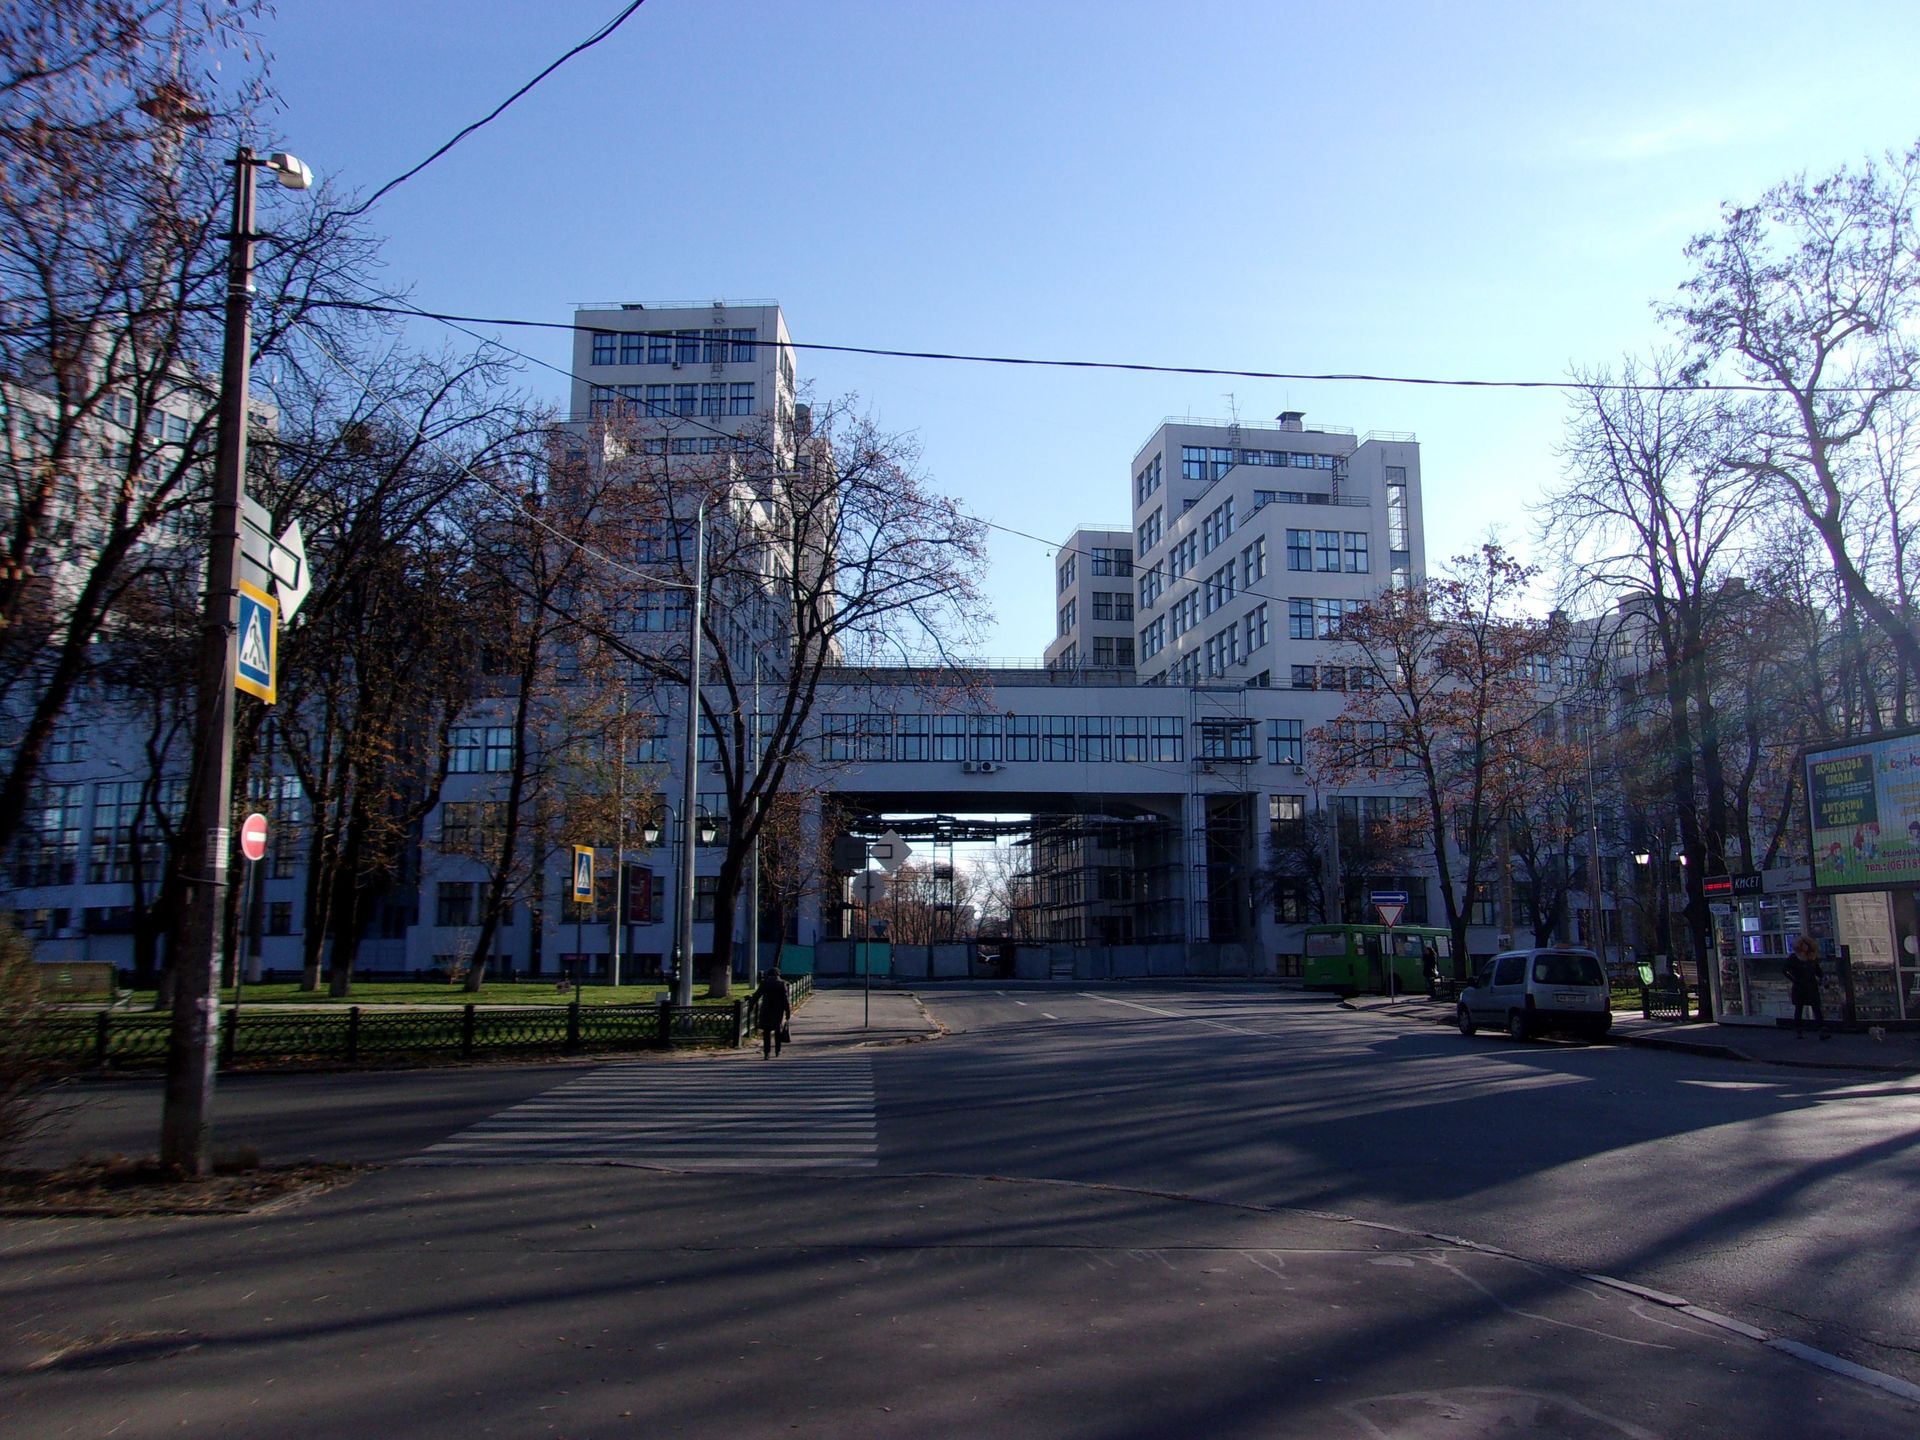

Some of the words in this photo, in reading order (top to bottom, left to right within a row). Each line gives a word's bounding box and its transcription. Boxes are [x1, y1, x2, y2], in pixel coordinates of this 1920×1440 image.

[1815, 758, 1863, 775] ПОЧАТКОВА
[1825, 771, 1856, 785] ШКОЛА
[1828, 812, 1858, 825] САДОК
[1734, 876, 1761, 889] КИСЕТ
